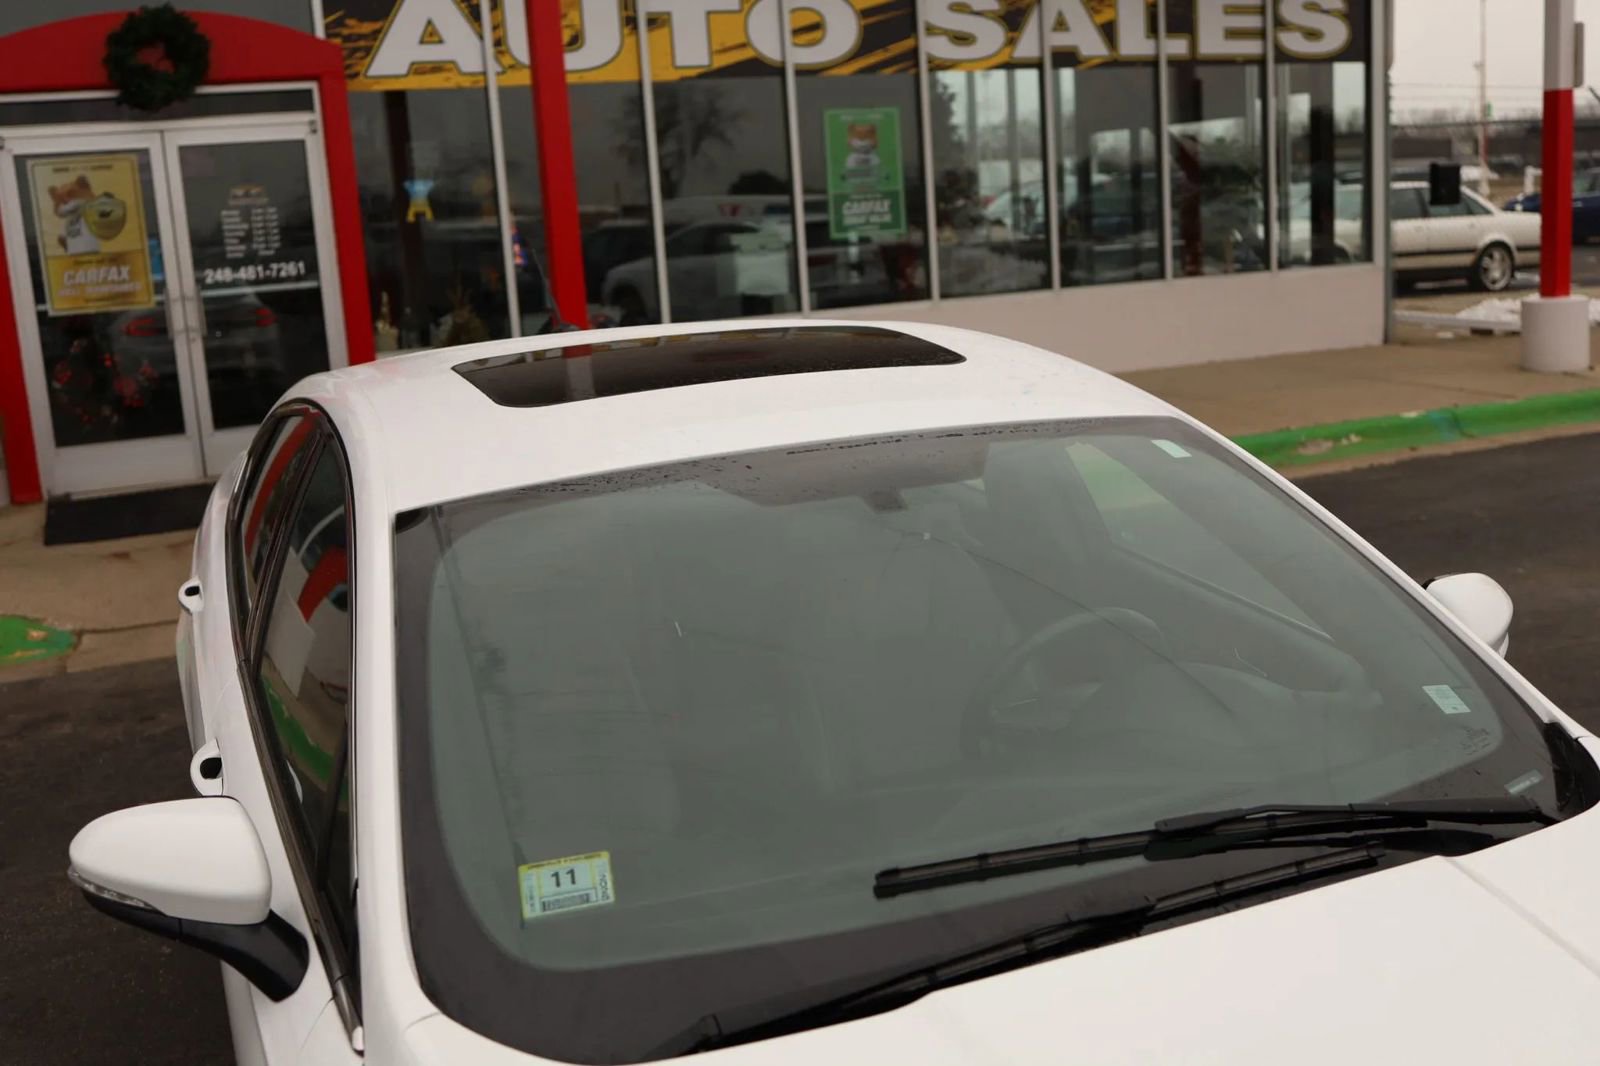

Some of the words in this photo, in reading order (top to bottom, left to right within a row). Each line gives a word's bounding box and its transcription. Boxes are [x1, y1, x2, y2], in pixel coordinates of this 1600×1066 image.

[364, 0, 862, 78] AUTO
[921, 0, 1351, 61] SALES
[64, 266, 130, 286] CARFAX
[551, 868, 576, 888] 11
